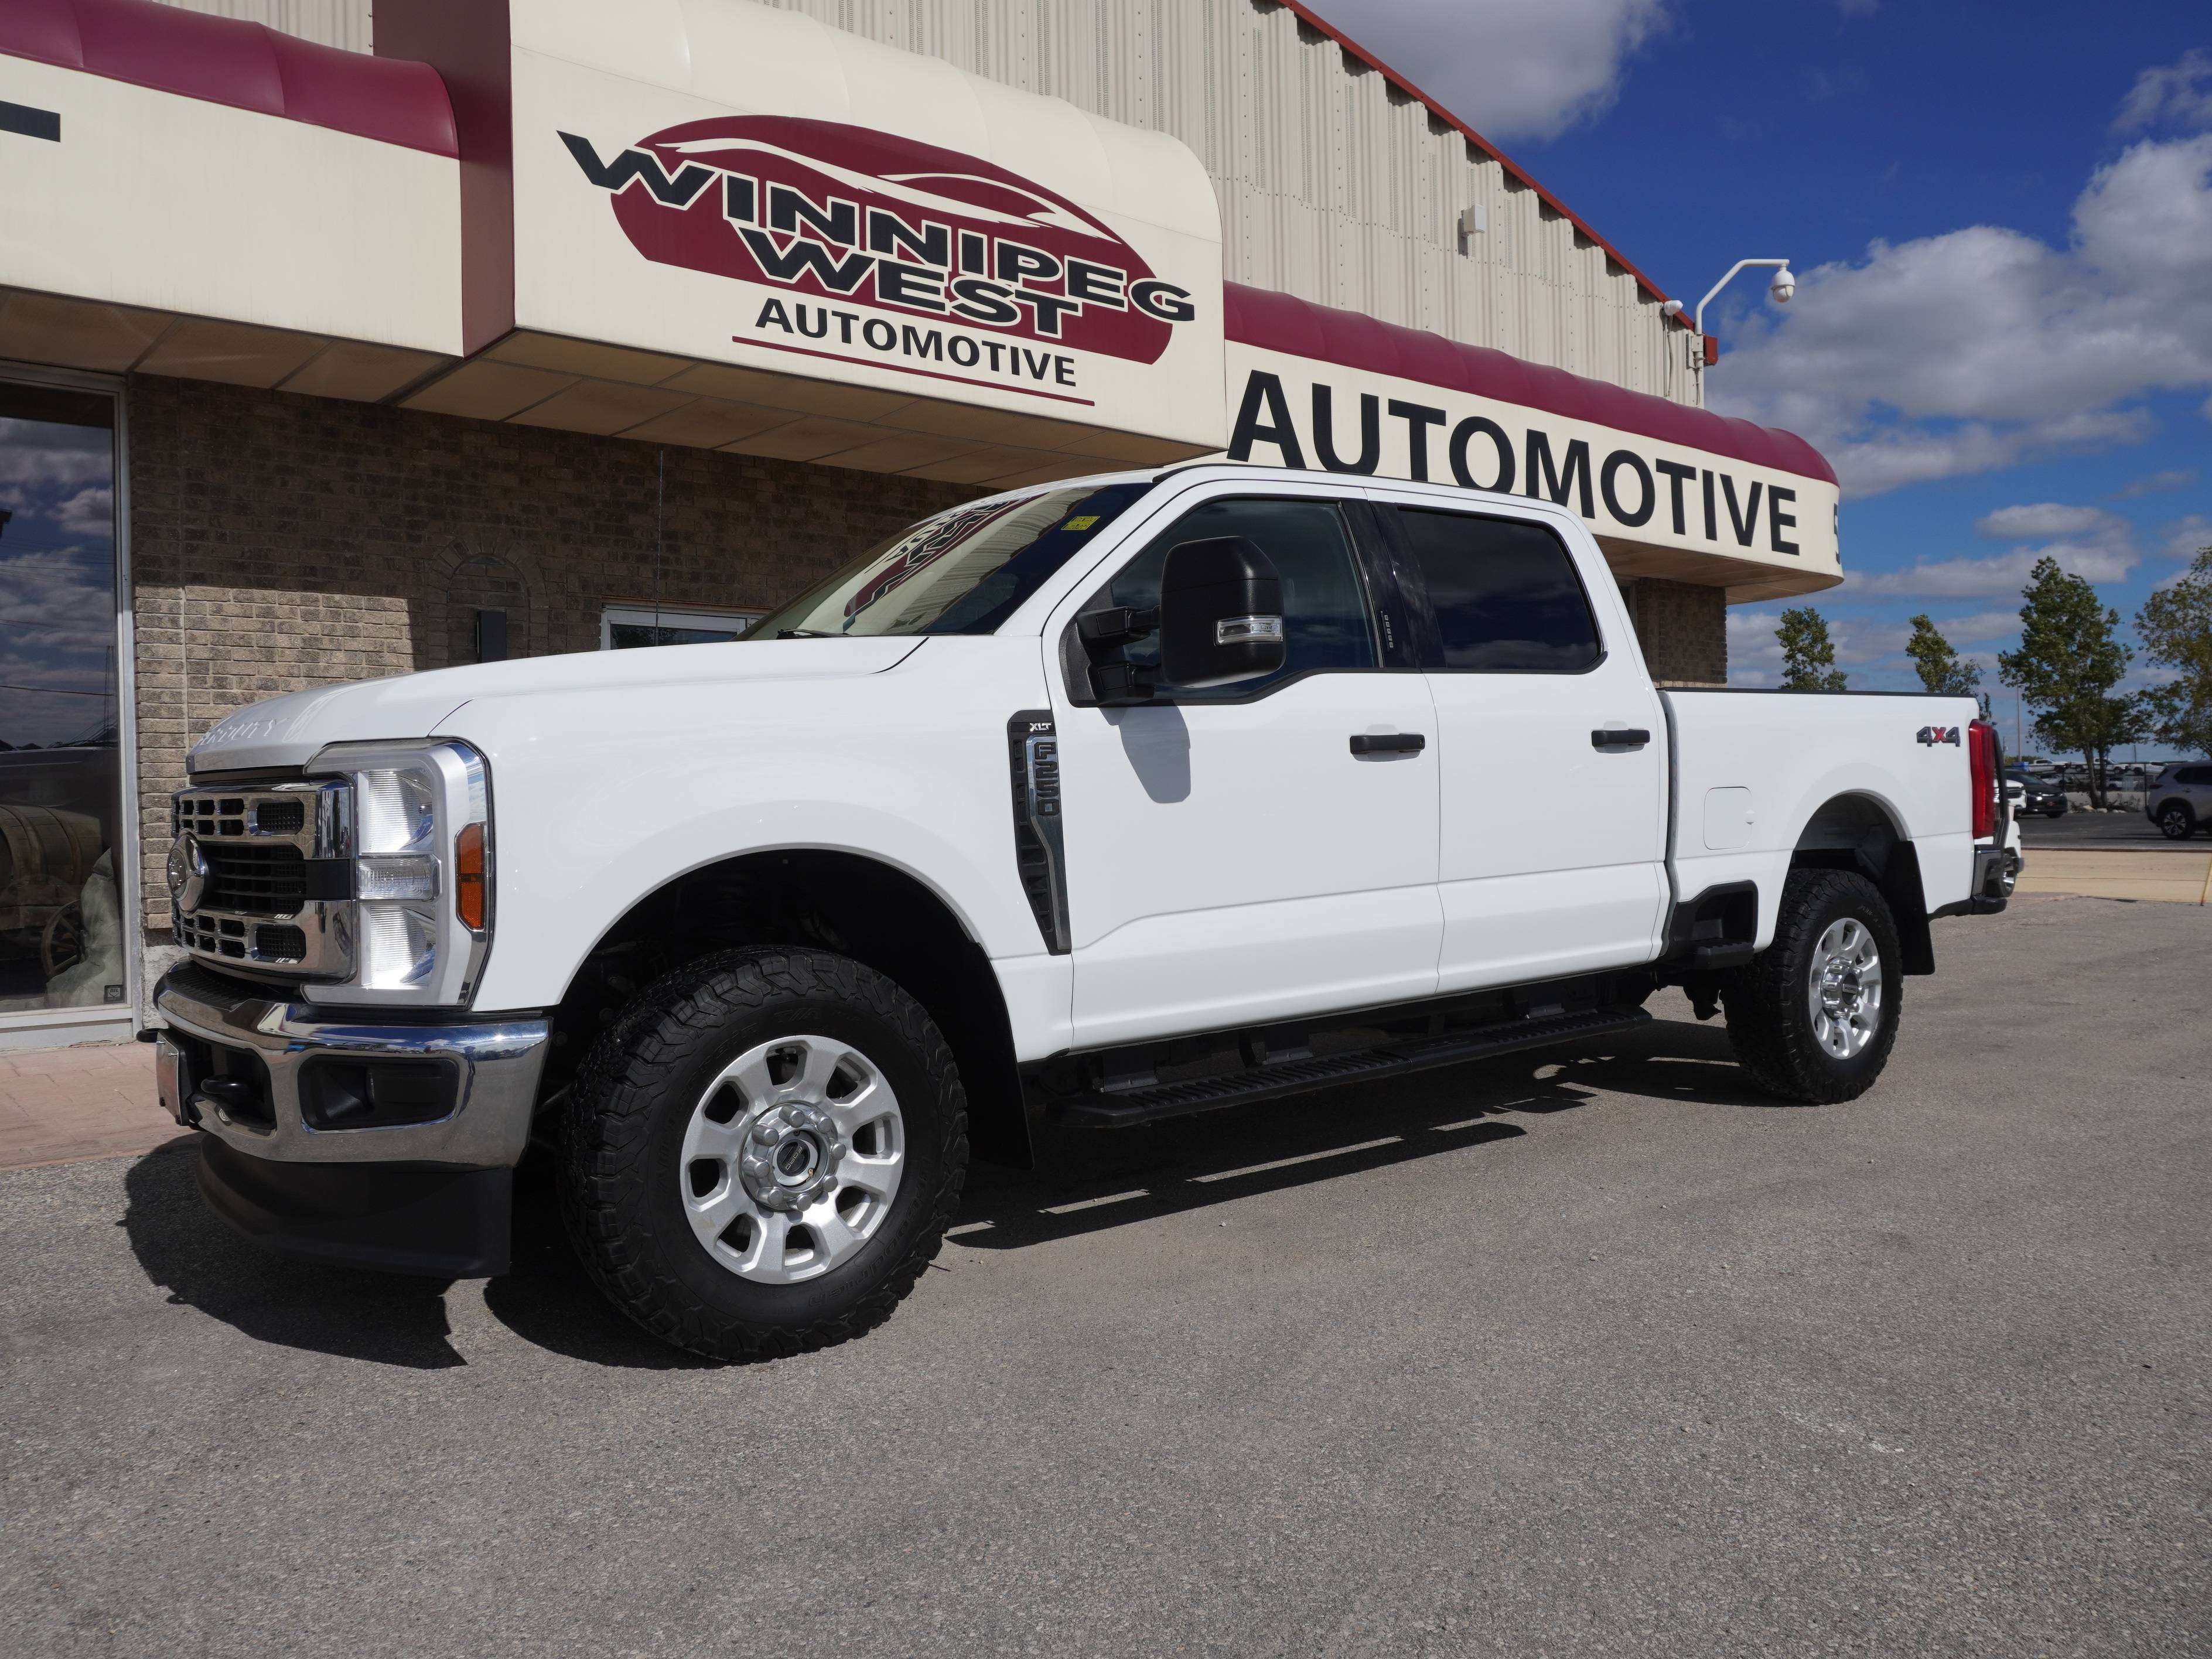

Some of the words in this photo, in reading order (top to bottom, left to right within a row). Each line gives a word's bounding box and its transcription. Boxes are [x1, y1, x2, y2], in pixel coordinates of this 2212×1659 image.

[557, 130, 1195, 322] WINNIPEG
[738, 227, 1078, 334] WEST
[755, 298, 1077, 387] AUTOMOTIVE
[1226, 369, 1800, 556] AUTOMOTIVE
[1029, 721, 1053, 732] XLT
[786, 1146, 803, 1170] FORD
